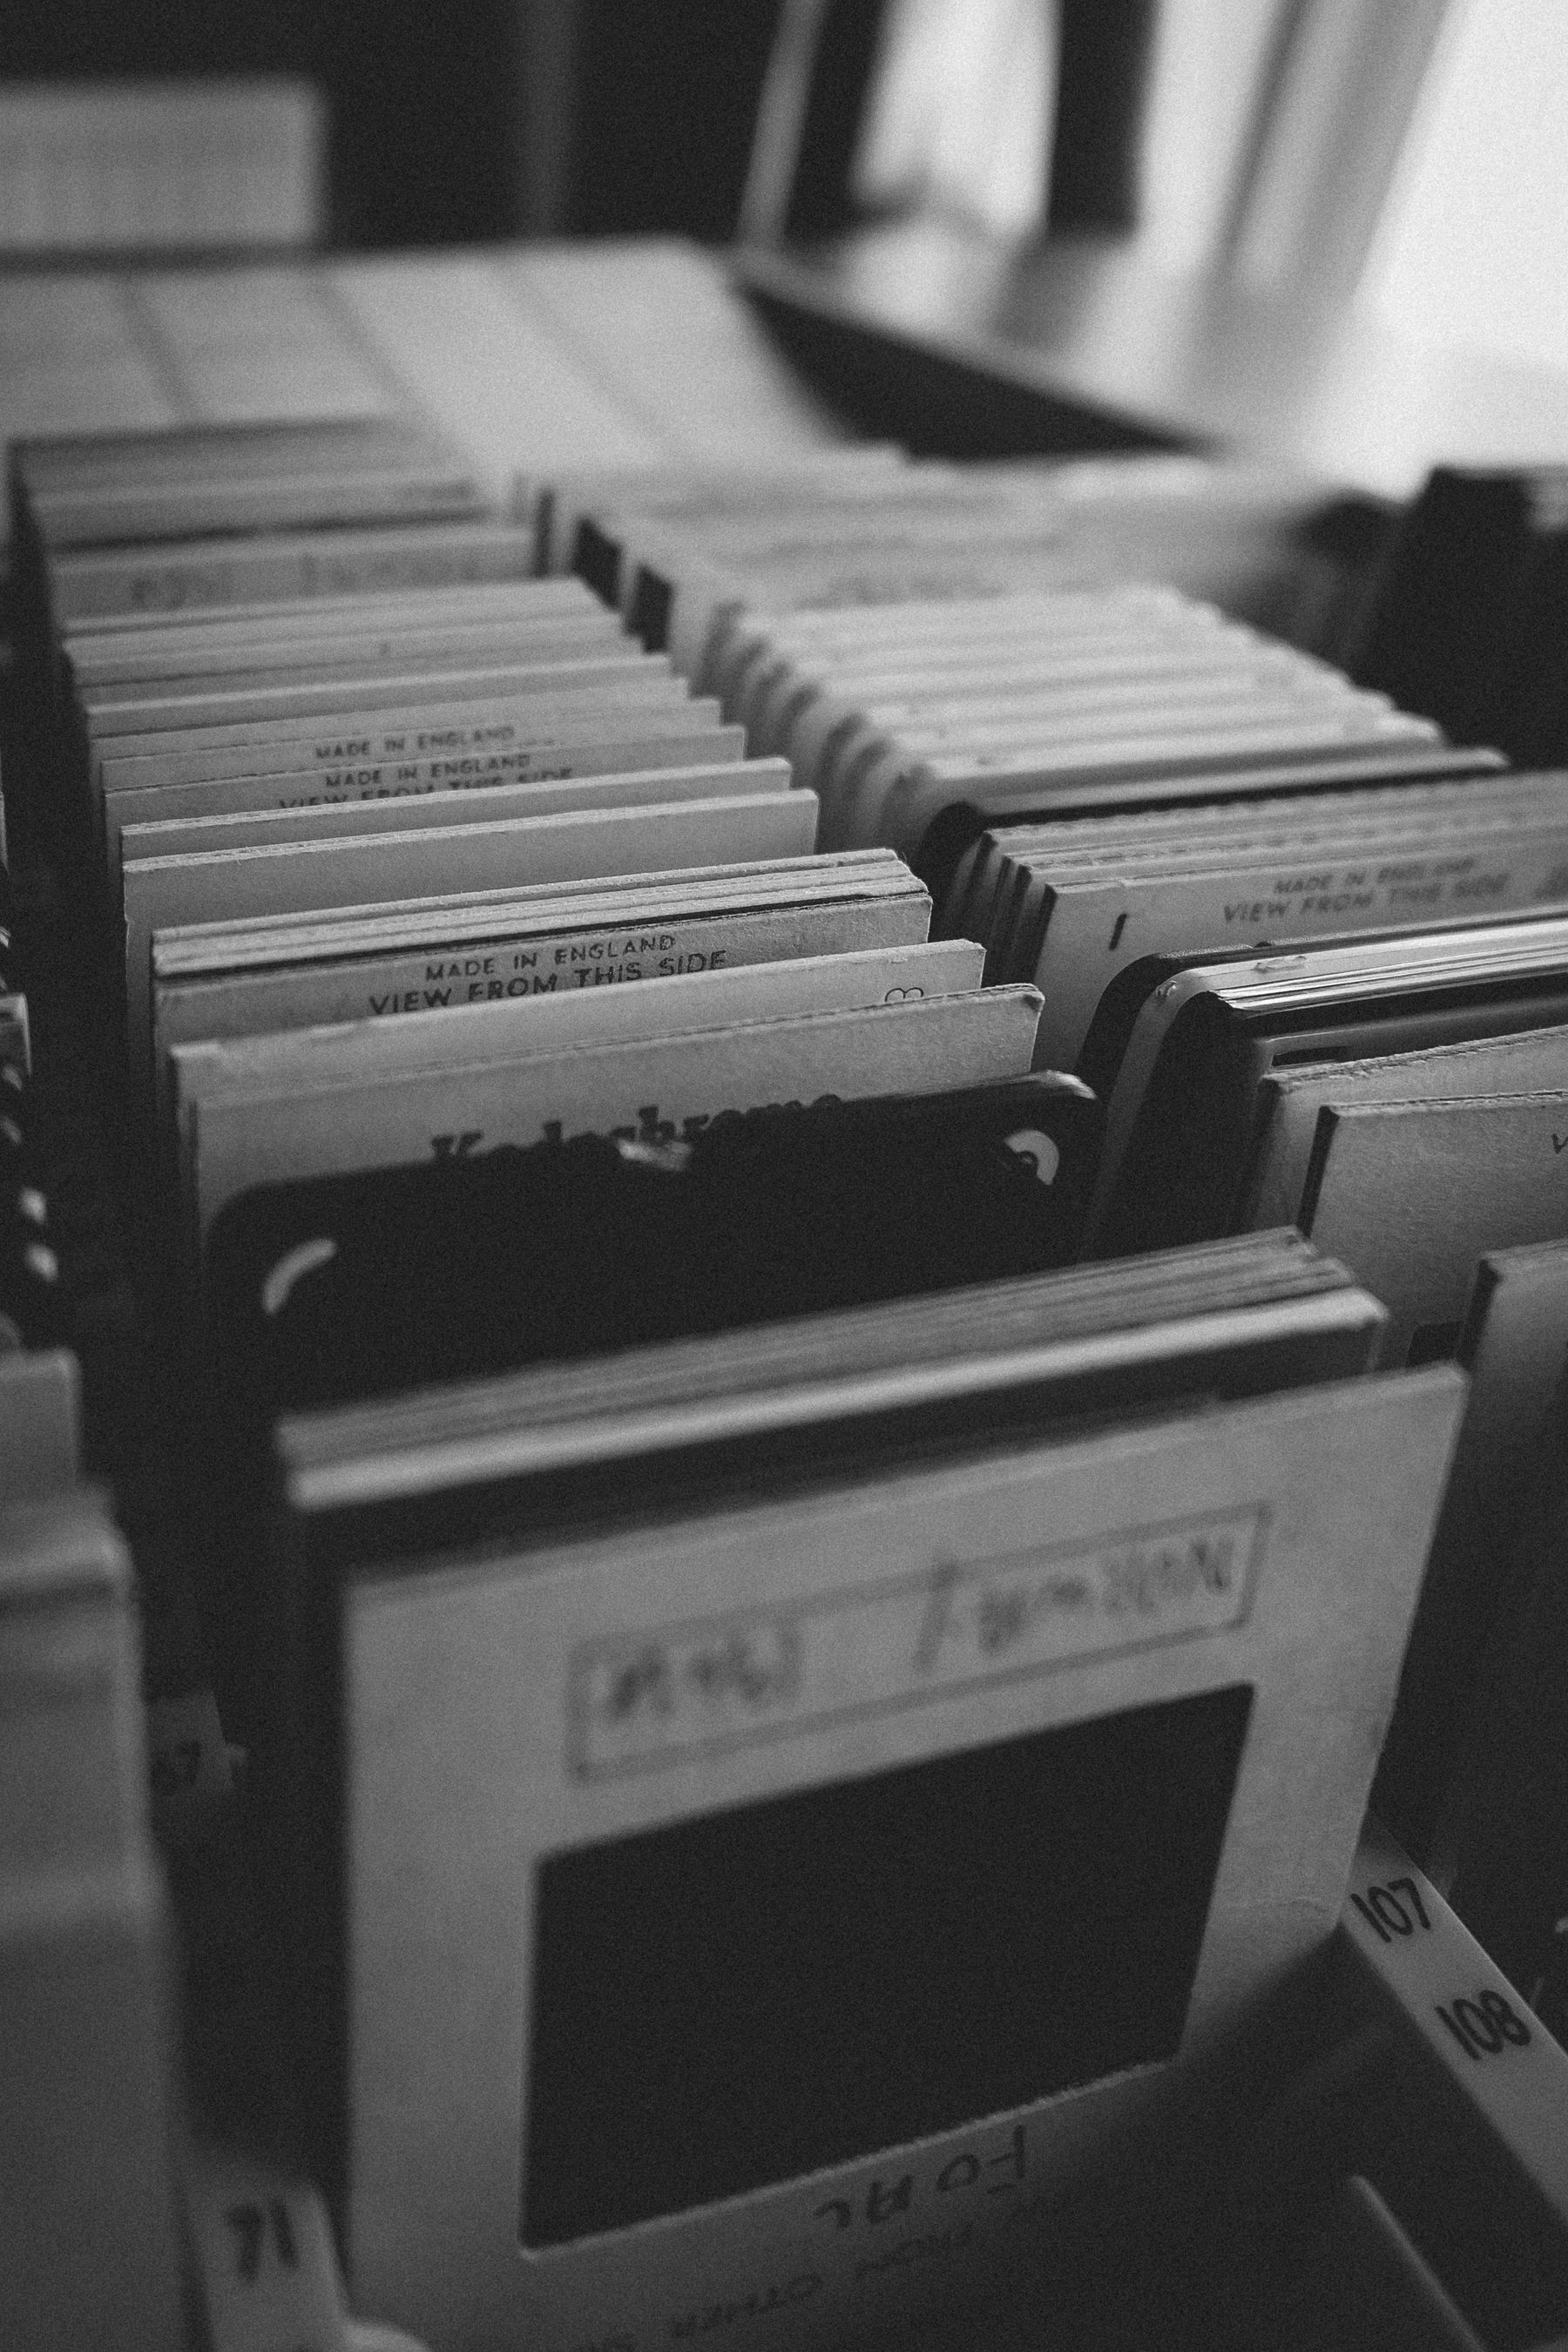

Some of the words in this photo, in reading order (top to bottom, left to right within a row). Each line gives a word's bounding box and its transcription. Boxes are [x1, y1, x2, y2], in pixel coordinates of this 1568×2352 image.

[316, 741, 370, 759] MADE
[385, 737, 404, 751] IN
[418, 726, 514, 750] ENGLAND
[325, 769, 382, 787] MADE
[398, 767, 417, 780] IN
[430, 754, 530, 778] ENGLAND
[1274, 874, 1332, 894] MADE
[1345, 872, 1365, 886] IN
[1224, 901, 1290, 923] VIEW
[1300, 890, 1374, 916] FROM
[425, 958, 495, 982] MADE
[514, 952, 537, 970] IN
[555, 935, 676, 964] ENGLAND
[369, 987, 452, 1016] VIEW
[468, 973, 558, 1003] FROM
[575, 962, 643, 988] THIS
[659, 950, 727, 976] SIDE
[1350, 1877, 1431, 1943] 107
[1434, 1990, 1531, 2061] 108
